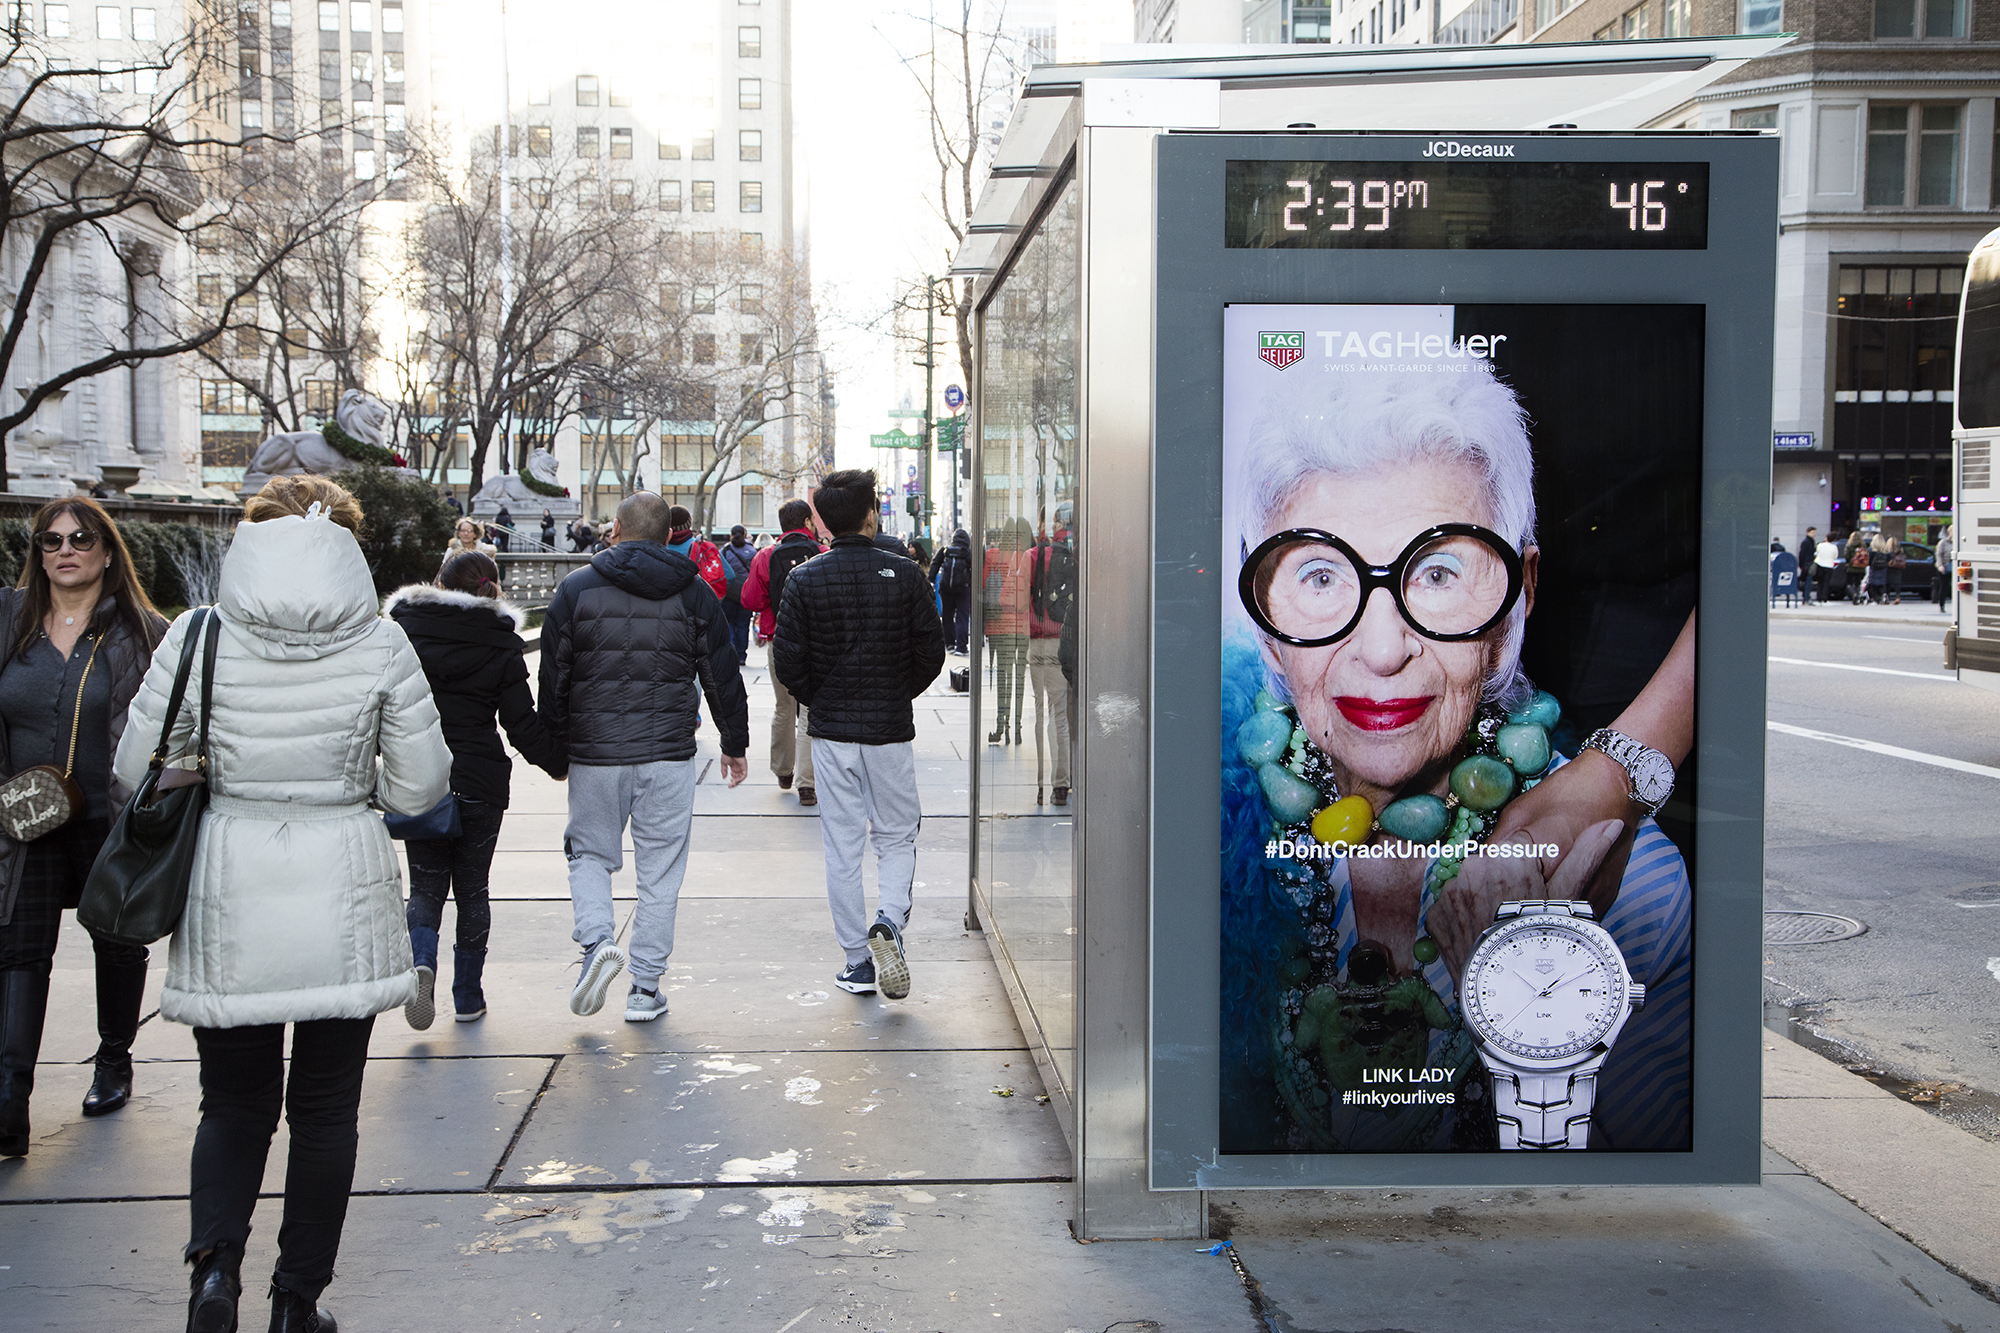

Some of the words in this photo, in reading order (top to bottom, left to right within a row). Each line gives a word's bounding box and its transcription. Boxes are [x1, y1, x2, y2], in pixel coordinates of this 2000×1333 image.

[1422, 141, 1515, 157] JCDecaux
[1263, 334, 1300, 346] TAG
[1261, 349, 1301, 367] HEUER
[1323, 363, 1356, 373] SWISS
[1358, 363, 1433, 373] AVANT-GARDE
[1437, 363, 1468, 373] SINCE
[1472, 363, 1496, 373] 1860
[873, 437, 893, 446] West
[893, 437, 908, 446] 41st
[909, 437, 918, 446] St
[1798, 436, 1808, 445] St
[1, 778, 41, 808] Blind
[12, 818, 30, 839] for
[1264, 839, 1560, 859] #DontCrackUnderPressure
[1363, 1068, 1404, 1083] LINK
[1409, 1068, 1456, 1083] LADY
[1342, 1089, 1456, 1108] #linkyourlives
